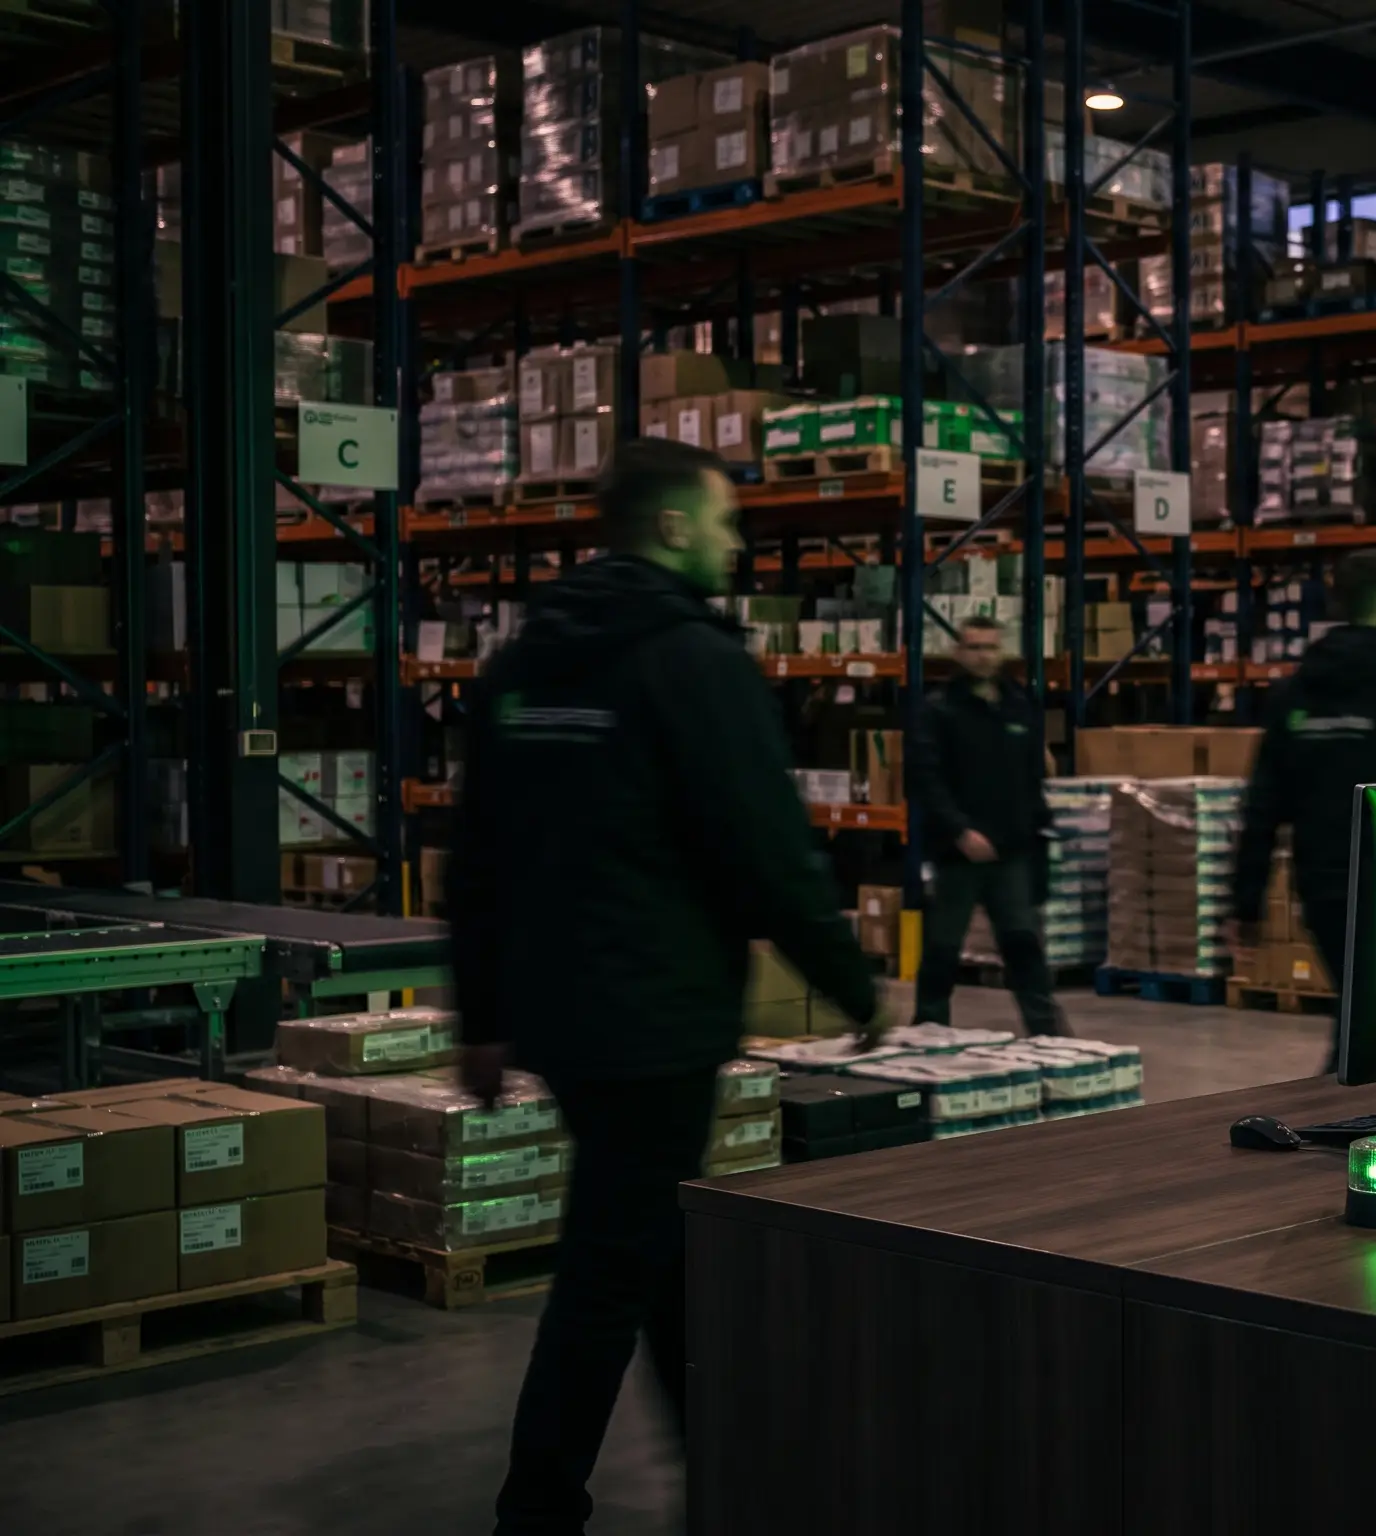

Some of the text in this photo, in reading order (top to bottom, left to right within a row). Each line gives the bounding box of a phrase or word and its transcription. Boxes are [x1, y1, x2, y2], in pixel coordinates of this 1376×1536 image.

[338, 440, 359, 469] C
[944, 479, 956, 503] E
[1155, 497, 1170, 520] D
